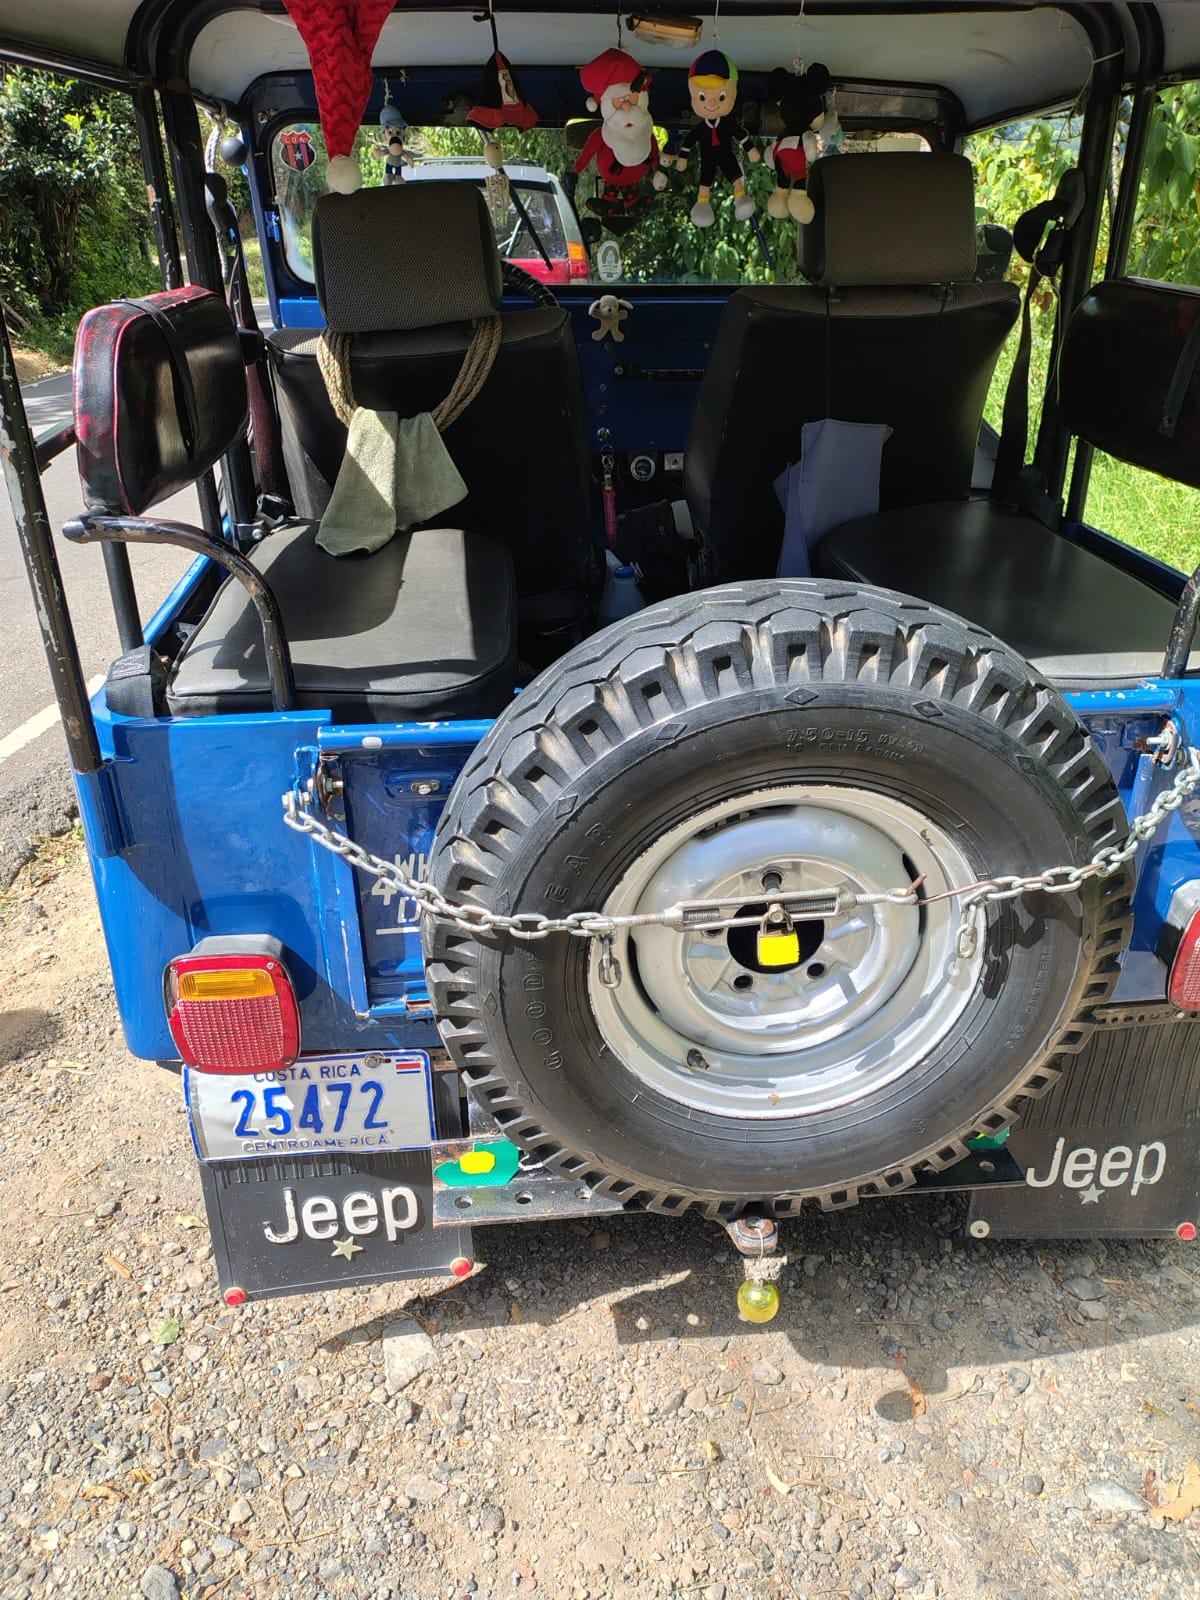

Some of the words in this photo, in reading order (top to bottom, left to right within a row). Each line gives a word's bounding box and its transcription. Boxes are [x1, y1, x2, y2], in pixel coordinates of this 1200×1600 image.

[523, 822, 615, 1071] GOODEAR
[253, 1066, 311, 1083] COSTA
[320, 1063, 361, 1079] RICA
[230, 1080, 389, 1137] 25472
[243, 1133, 388, 1153] CENTROAMERICA
[1025, 1136, 1167, 1196] Jeep
[262, 1186, 419, 1244] Jeep
